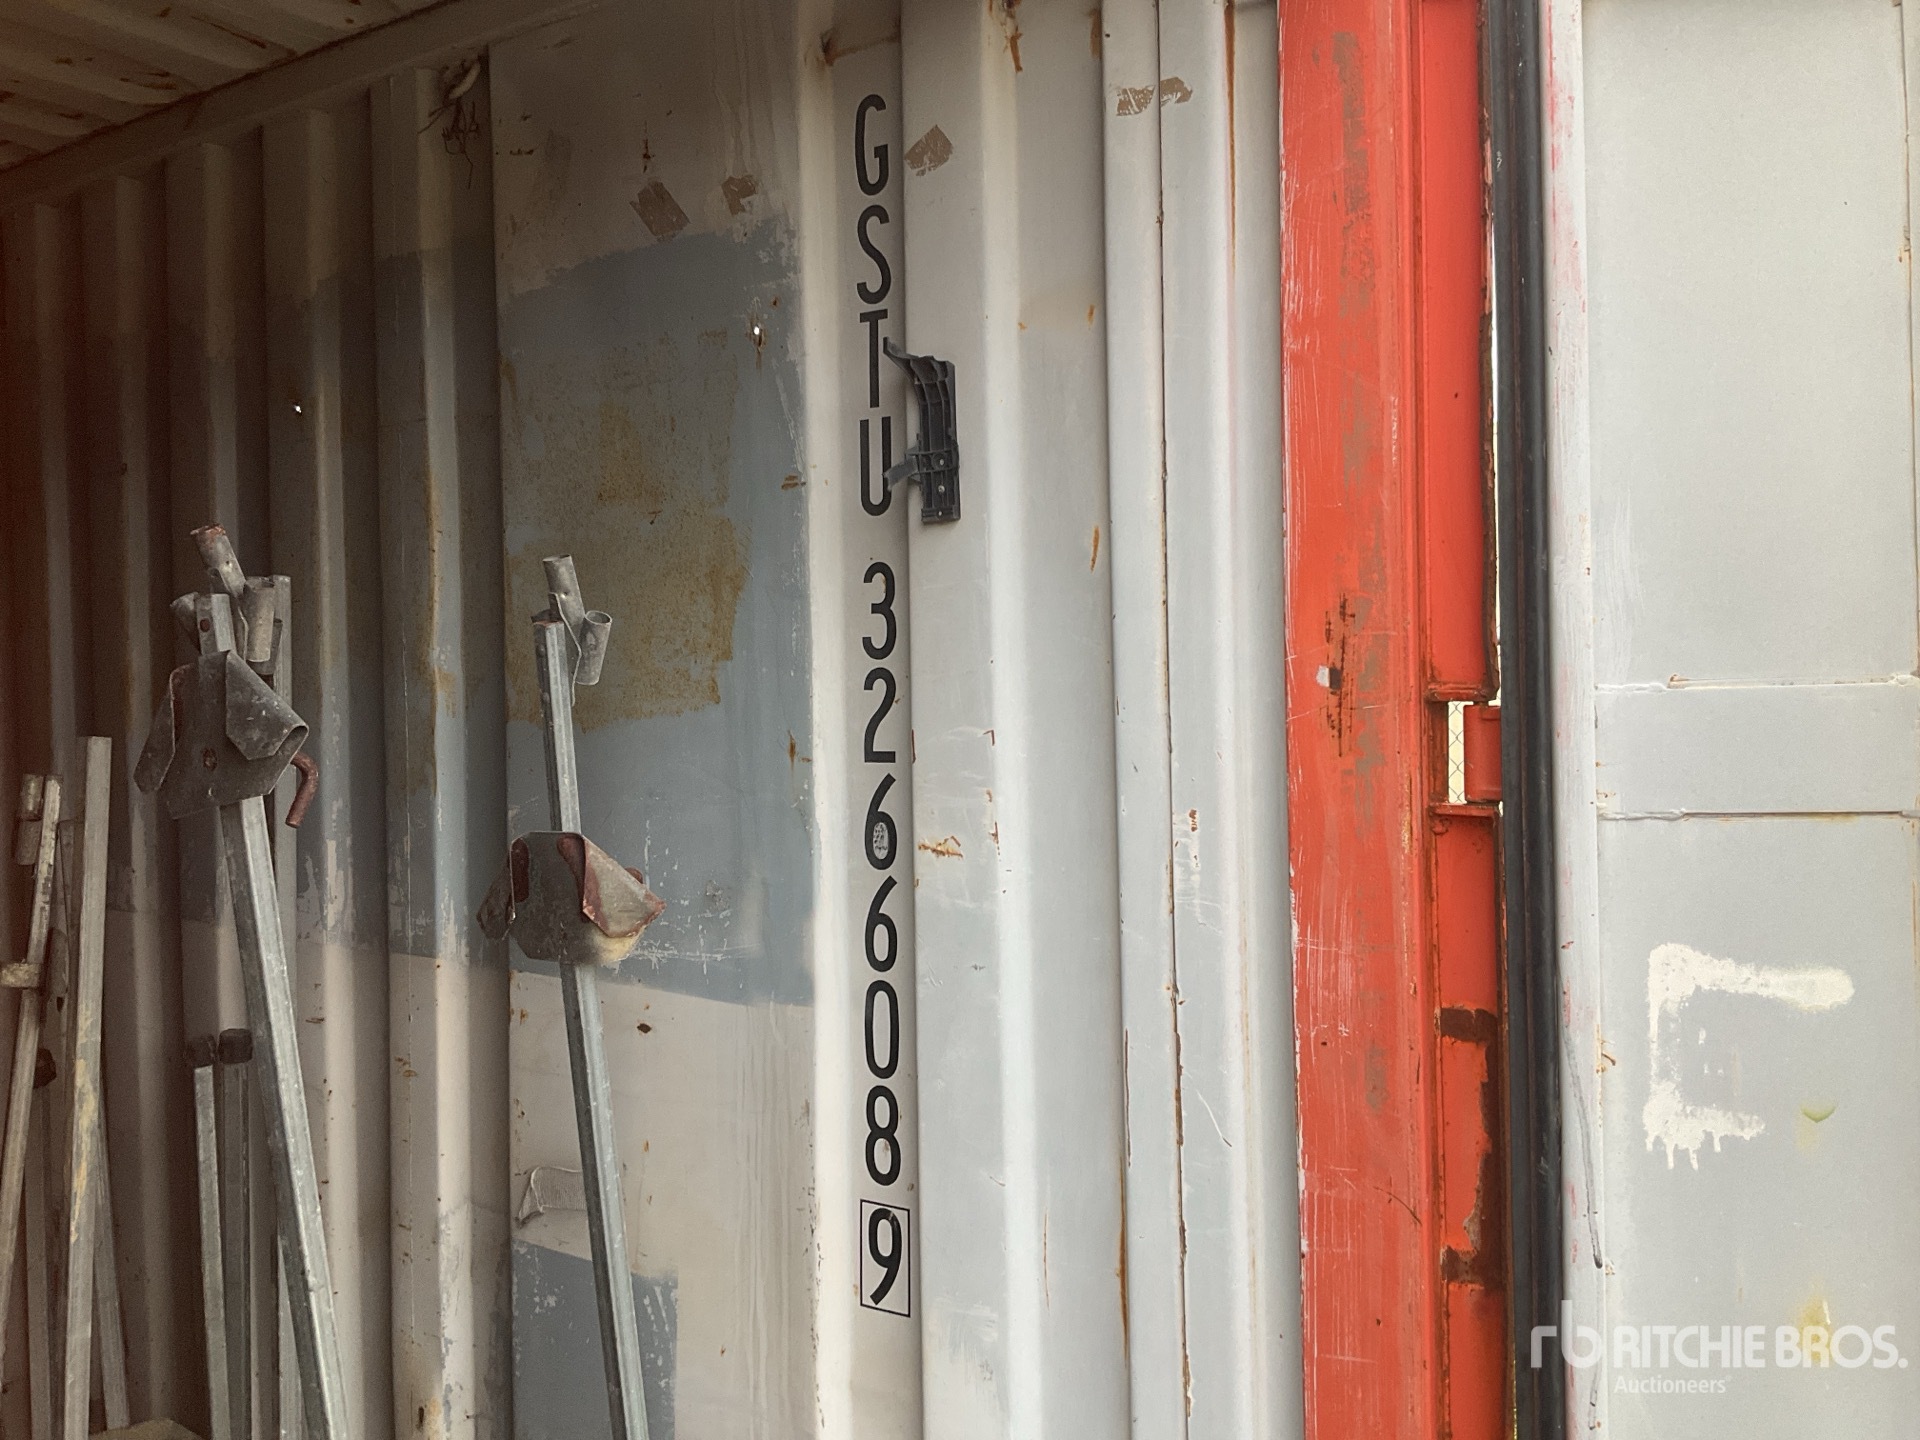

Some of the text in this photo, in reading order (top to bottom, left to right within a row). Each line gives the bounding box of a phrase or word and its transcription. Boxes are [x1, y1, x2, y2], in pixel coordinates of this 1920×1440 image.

[854, 93, 903, 1306] GSTU 326608 9
